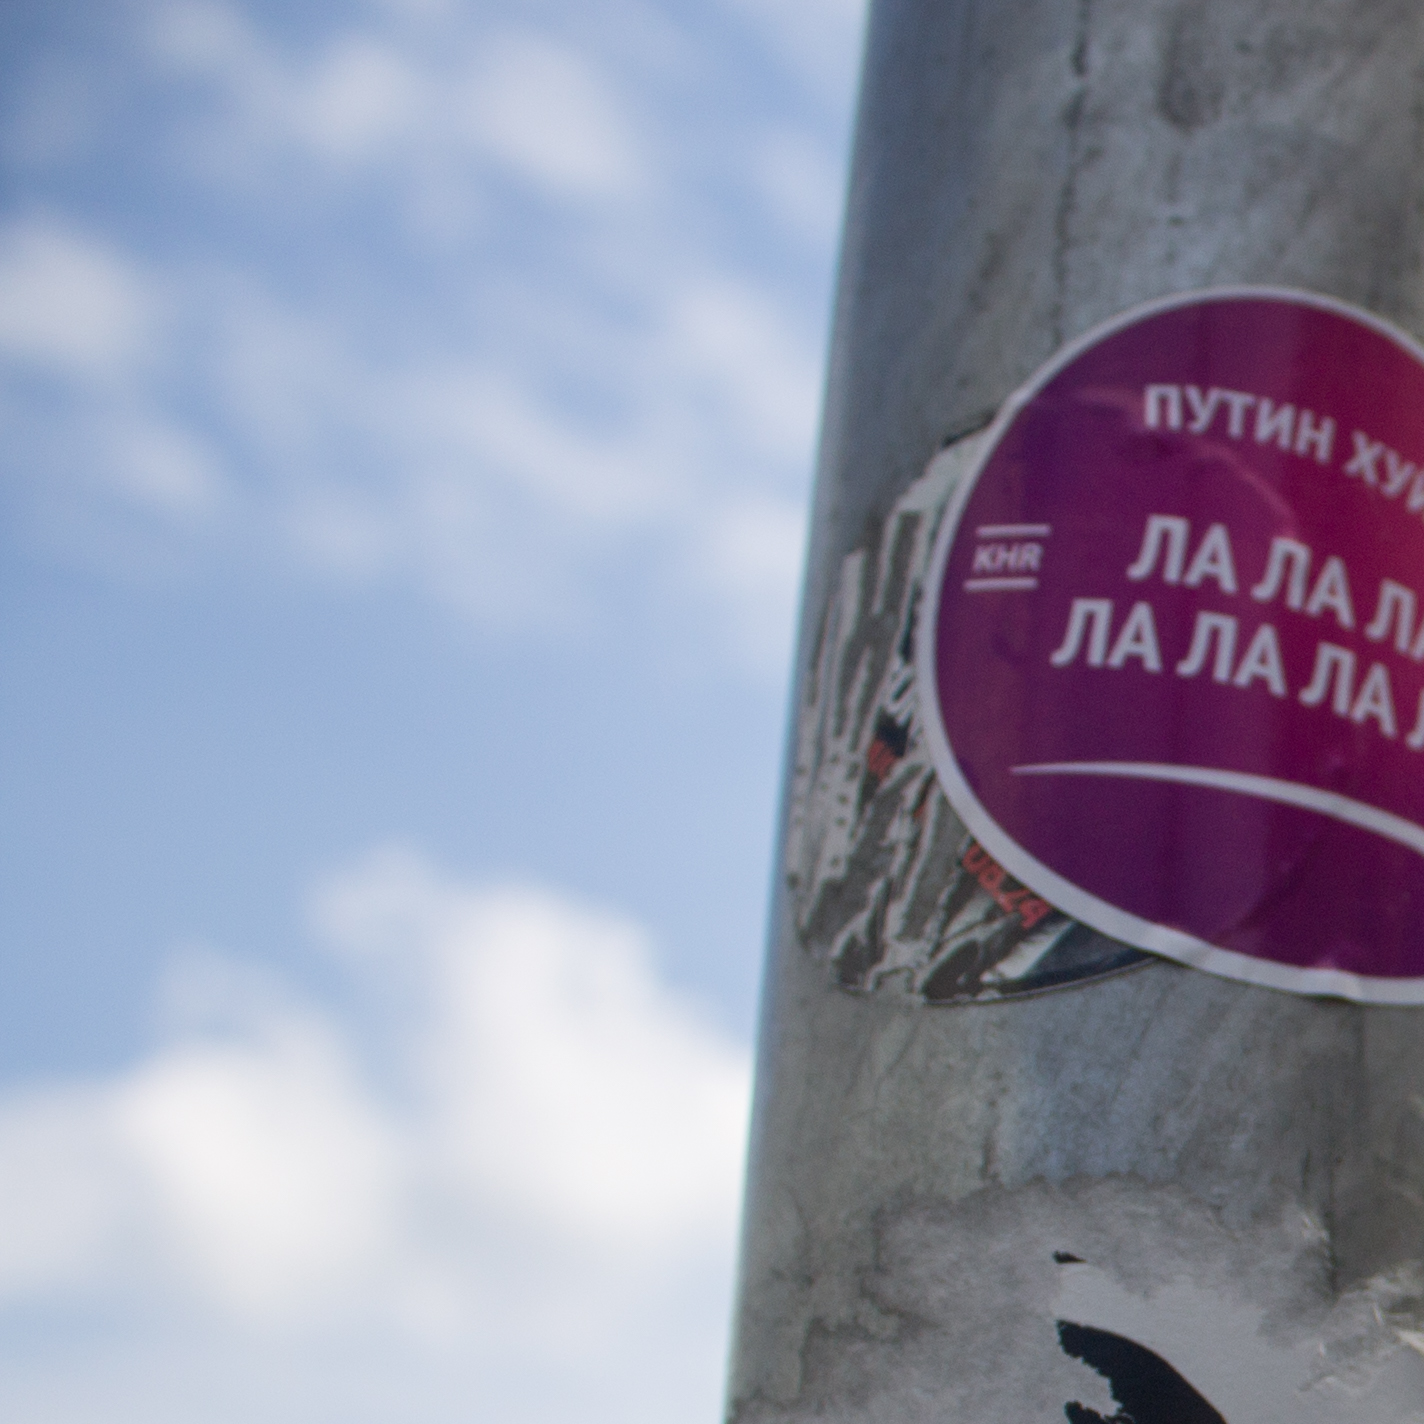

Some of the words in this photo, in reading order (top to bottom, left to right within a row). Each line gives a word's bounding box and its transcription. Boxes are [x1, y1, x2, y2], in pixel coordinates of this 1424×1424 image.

[1144, 382, 1337, 464] ПУТИН
[972, 543, 1044, 573] KHR
[1126, 513, 1239, 596] ЛА
[1250, 536, 1356, 631] ЛА
[1049, 598, 1163, 673] ЛА
[1176, 611, 1288, 697] ЛА
[1299, 642, 1398, 740] ЛА
